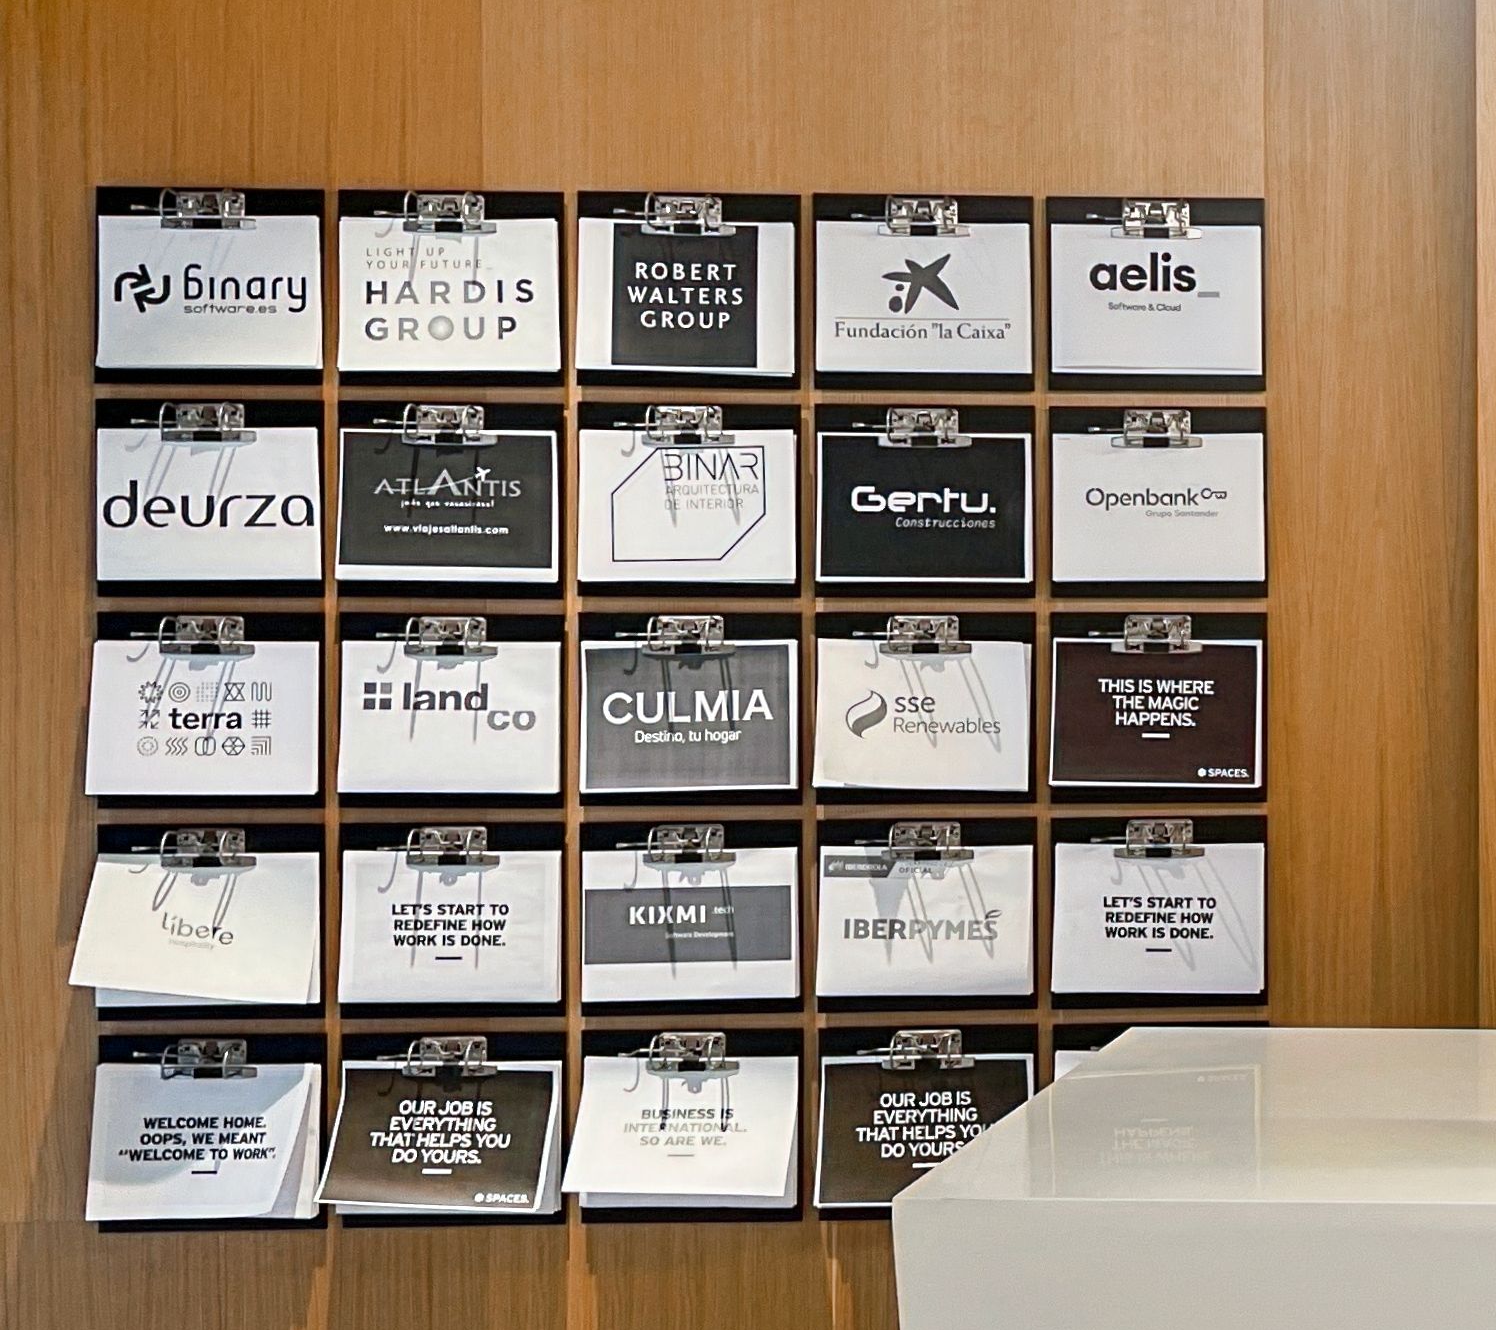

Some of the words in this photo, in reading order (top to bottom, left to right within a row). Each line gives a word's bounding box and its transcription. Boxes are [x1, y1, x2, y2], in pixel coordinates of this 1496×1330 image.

[366, 247, 414, 257] LIGHT
[426, 247, 445, 257] UP
[366, 260, 409, 269] YOUR
[635, 262, 736, 281] ROBERT
[183, 263, 307, 313] binary
[365, 279, 534, 305] HARDIS
[627, 286, 743, 305] WALTERS
[184, 303, 277, 314] software.es
[1108, 302, 1146, 311] Software
[1156, 303, 1181, 312] Cloud
[640, 310, 730, 329] GROUP
[365, 315, 517, 341] GROUP
[834, 321, 928, 339] Fundación
[664, 453, 758, 481] BINAR
[373, 468, 521, 497] ATLANTIS
[665, 484, 759, 495] ARQUITECTURA
[102, 479, 315, 528] deurza
[664, 499, 680, 509] DE
[686, 498, 744, 509] INTERIOR
[851, 485, 996, 514] Gertu.
[1085, 487, 1199, 511] Openbank
[1145, 510, 1172, 518] Grupo
[895, 517, 996, 529] Construcciones
[1098, 678, 1135, 693] THIS
[1139, 679, 1153, 693] IS
[1156, 679, 1214, 695] WHERE
[403, 682, 488, 711] land
[894, 696, 936, 713] sse
[1112, 695, 1145, 709] THE
[1148, 696, 1199, 711] MAGIC
[603, 689, 774, 725] CULMIA
[168, 708, 242, 730] terra
[487, 710, 536, 731] co
[893, 717, 1001, 734] Renewables
[1115, 712, 1196, 727] HAPPENS.
[634, 730, 686, 744] Destino,
[689, 731, 701, 741] tu
[705, 729, 742, 744] hogar
[392, 904, 432, 915] LET'S
[437, 904, 485, 915] START
[490, 904, 509, 915] TO
[1103, 896, 1142, 908] LET'S
[1147, 897, 1193, 909] START
[1197, 897, 1216, 909] TO
[629, 905, 706, 925] KIXMI
[1105, 912, 1177, 923] REDEFINE
[1181, 913, 1214, 924] HOW
[394, 919, 467, 931] REDEFINE
[471, 919, 506, 931] HOW
[844, 918, 998, 941] IBERPYMES
[1105, 927, 1147, 939] WORK
[1152, 927, 1166, 939] IS
[1170, 928, 1214, 939] DONE.
[393, 935, 437, 946] WORK
[442, 935, 455, 946] IS
[461, 935, 506, 946] DONE.
[880, 1093, 916, 1108] OUR
[918, 1091, 953, 1107] JOB
[956, 1091, 971, 1105] IS
[399, 1100, 437, 1116] OUR
[438, 1100, 474, 1116] JOB
[477, 1101, 493, 1116] IS
[641, 1109, 716, 1119] BUSINESS
[720, 1109, 734, 1119] IS
[873, 1107, 978, 1125] EVERYTHING
[144, 1117, 219, 1129] WELCOME
[223, 1117, 266, 1129] HOME.
[390, 1116, 497, 1132] EVERYTHING
[624, 1122, 747, 1133] INTERNATIONAL.
[140, 1133, 187, 1146] OOPS,
[192, 1133, 215, 1145] WE
[218, 1132, 266, 1144] MEANT
[370, 1132, 414, 1147] THAT
[416, 1132, 472, 1148] HELPS
[475, 1133, 511, 1149] YOU
[640, 1136, 660, 1146] SO
[664, 1136, 695, 1146] ARE
[701, 1136, 727, 1146] WE.
[855, 1127, 899, 1142] THAT
[902, 1125, 956, 1140] HELPS
[210, 1149, 228, 1160] TO
[391, 1149, 418, 1163] DO
[421, 1149, 482, 1164] YOURS.
[881, 1143, 905, 1158] DO
